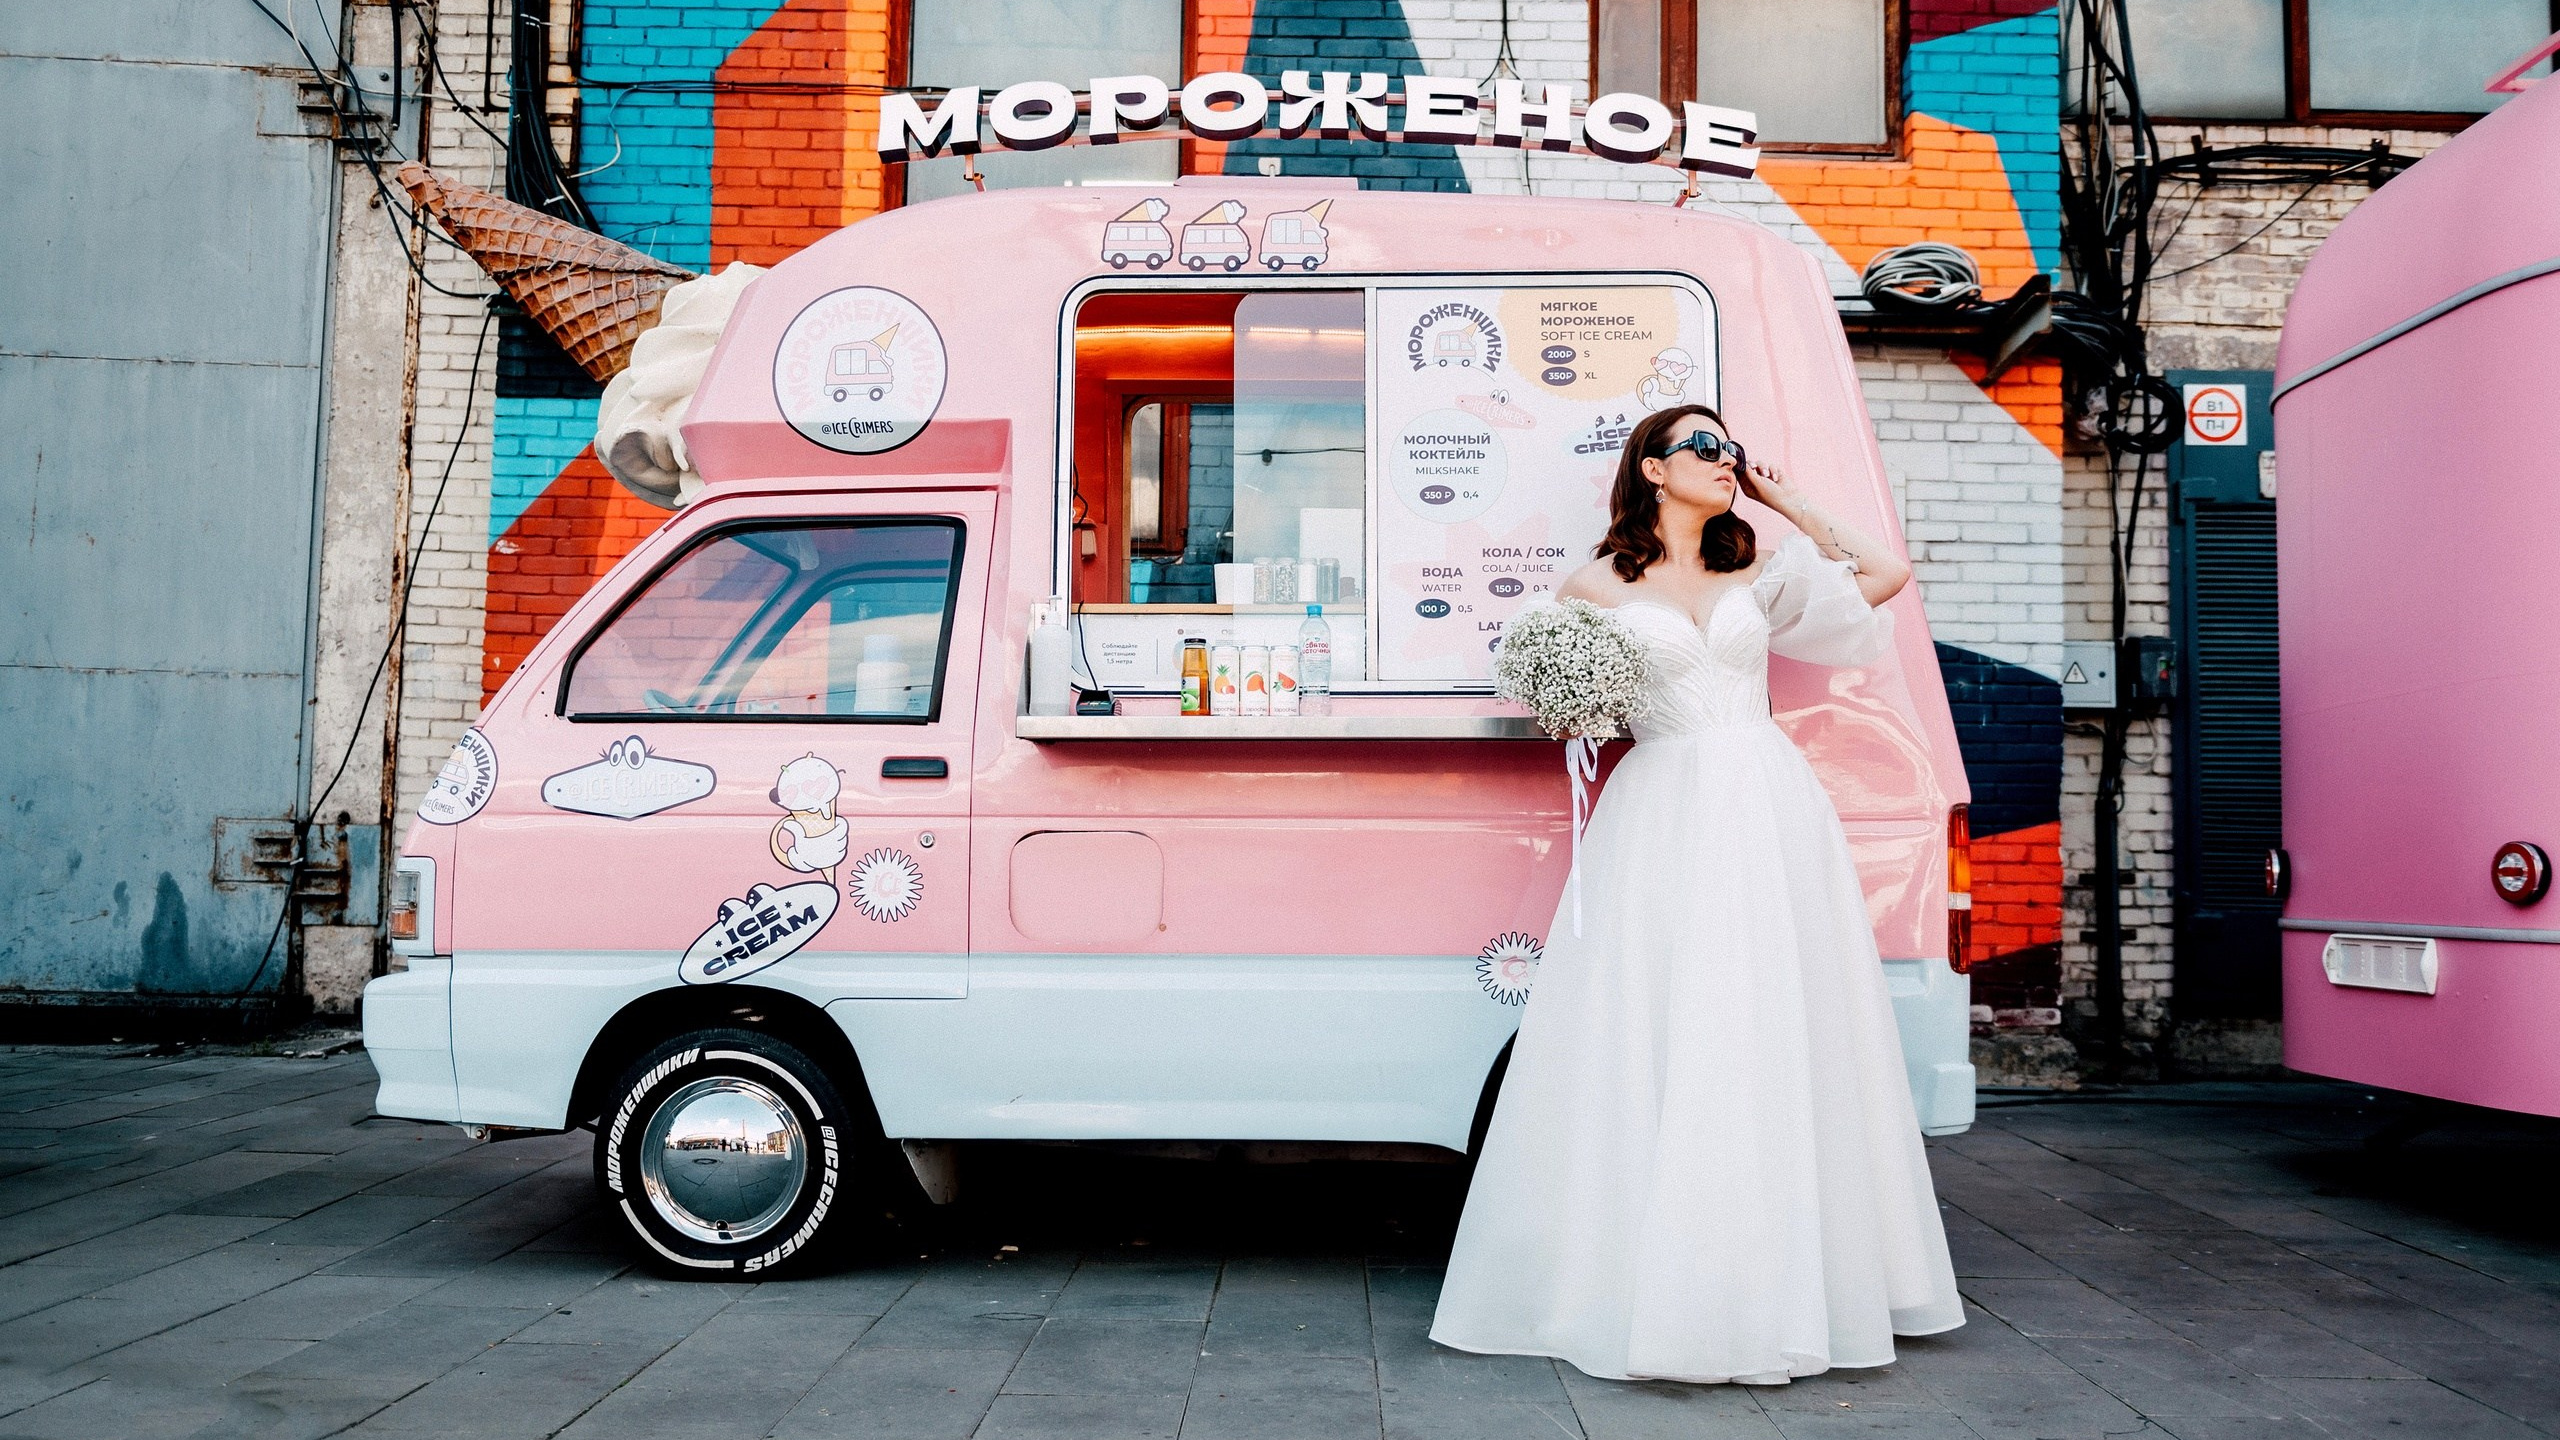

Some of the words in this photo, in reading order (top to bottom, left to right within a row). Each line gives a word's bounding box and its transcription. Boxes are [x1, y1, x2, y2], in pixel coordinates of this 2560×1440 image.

[878, 71, 1761, 179] МОРОЖЕНОЕ
[1540, 302, 1598, 312] МЯГКОЕ
[1540, 315, 1635, 327] МОРОЖЕНОЕ
[1407, 303, 1502, 373] МОРОЖЕНЩИКИ
[1540, 330, 1575, 341] SOFT
[1579, 330, 1601, 341] ICE
[1603, 330, 1653, 341] CREAM
[1583, 350, 1590, 358] S
[1584, 371, 1597, 380] XL
[1403, 432, 1491, 445] МОЛОЧНЫЙ
[1595, 427, 1631, 441] ICE
[1409, 447, 1486, 460] КОКТЕЙЛЬ
[1415, 466, 1480, 475] MILKSHAKE
[1463, 490, 1479, 500] 0,4
[1482, 547, 1523, 558] КОЛА
[1536, 547, 1566, 558] СОК
[1422, 568, 1463, 578] ВОДА
[1482, 564, 1513, 573] COLA
[1522, 564, 1554, 573] JUICE
[1422, 584, 1462, 592] WATER
[1458, 605, 1473, 614] 0,5
[1102, 642, 1138, 650] Соблюдайте
[460, 734, 491, 808] ЕНЩИКИ
[725, 904, 781, 945] ICE
[703, 904, 819, 976] CREAM
[607, 1047, 700, 1193] МОРОЖЕНЩИКИ
[743, 1125, 839, 1273] @ICECRIMERS
